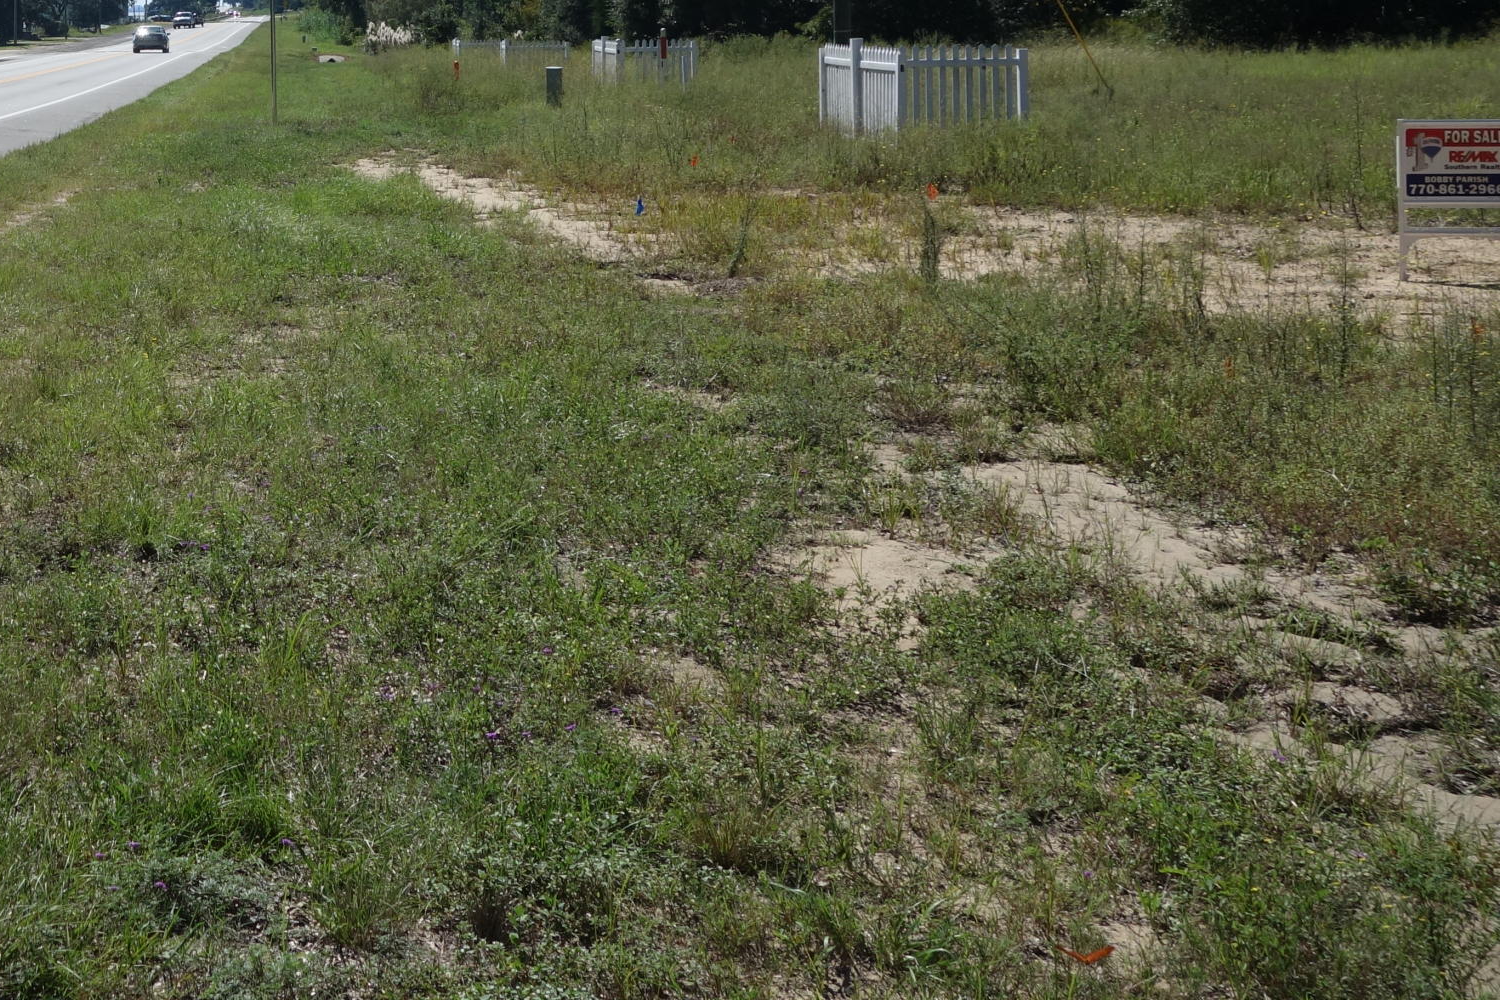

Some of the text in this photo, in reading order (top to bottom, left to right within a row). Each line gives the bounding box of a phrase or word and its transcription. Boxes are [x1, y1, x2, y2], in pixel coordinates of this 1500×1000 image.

[1444, 130, 1470, 143] FOR
[1473, 130, 1500, 143] SAL
[1449, 151, 1498, 162] RE/MAX
